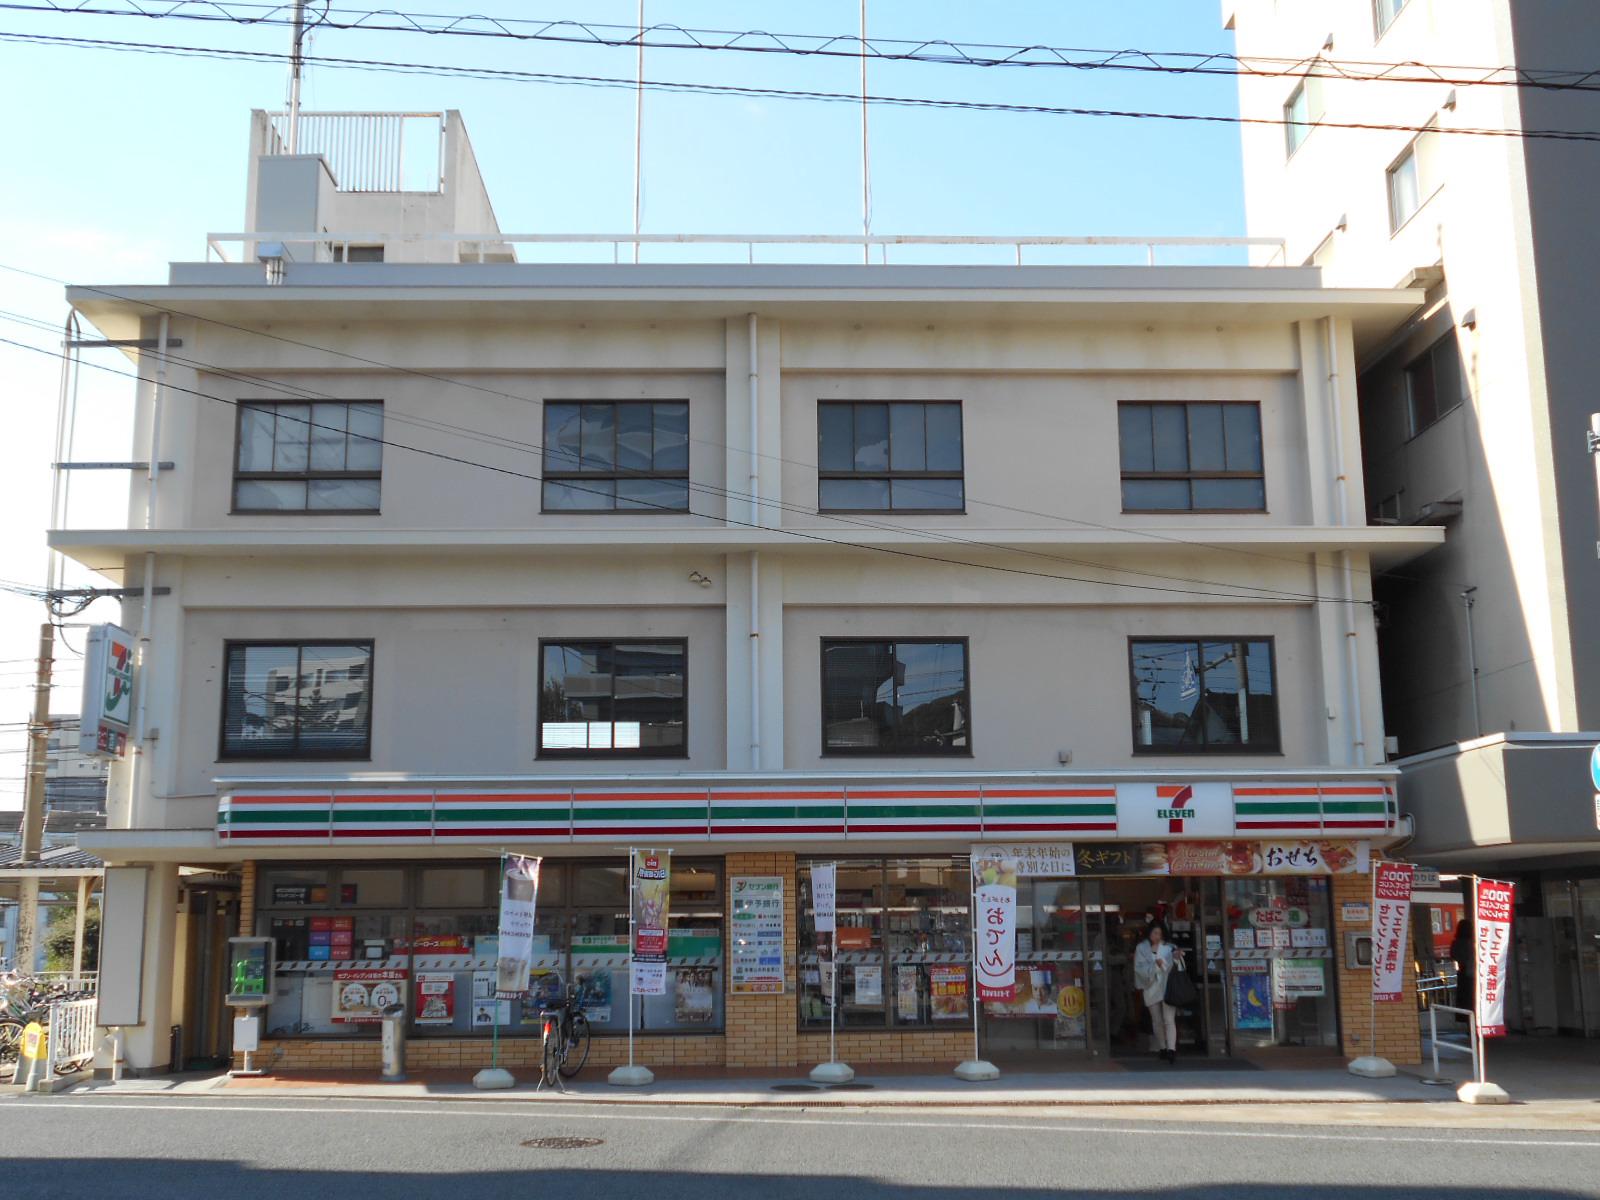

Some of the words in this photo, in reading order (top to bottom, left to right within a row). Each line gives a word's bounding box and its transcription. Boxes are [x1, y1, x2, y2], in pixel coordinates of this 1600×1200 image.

[1011, 846, 1071, 860] 年末年始の
[1078, 849, 1131, 869] 冬ギフト
[1265, 846, 1318, 867] おせち
[749, 883, 779, 891] セブン銀行
[1256, 910, 1284, 922] たばこ
